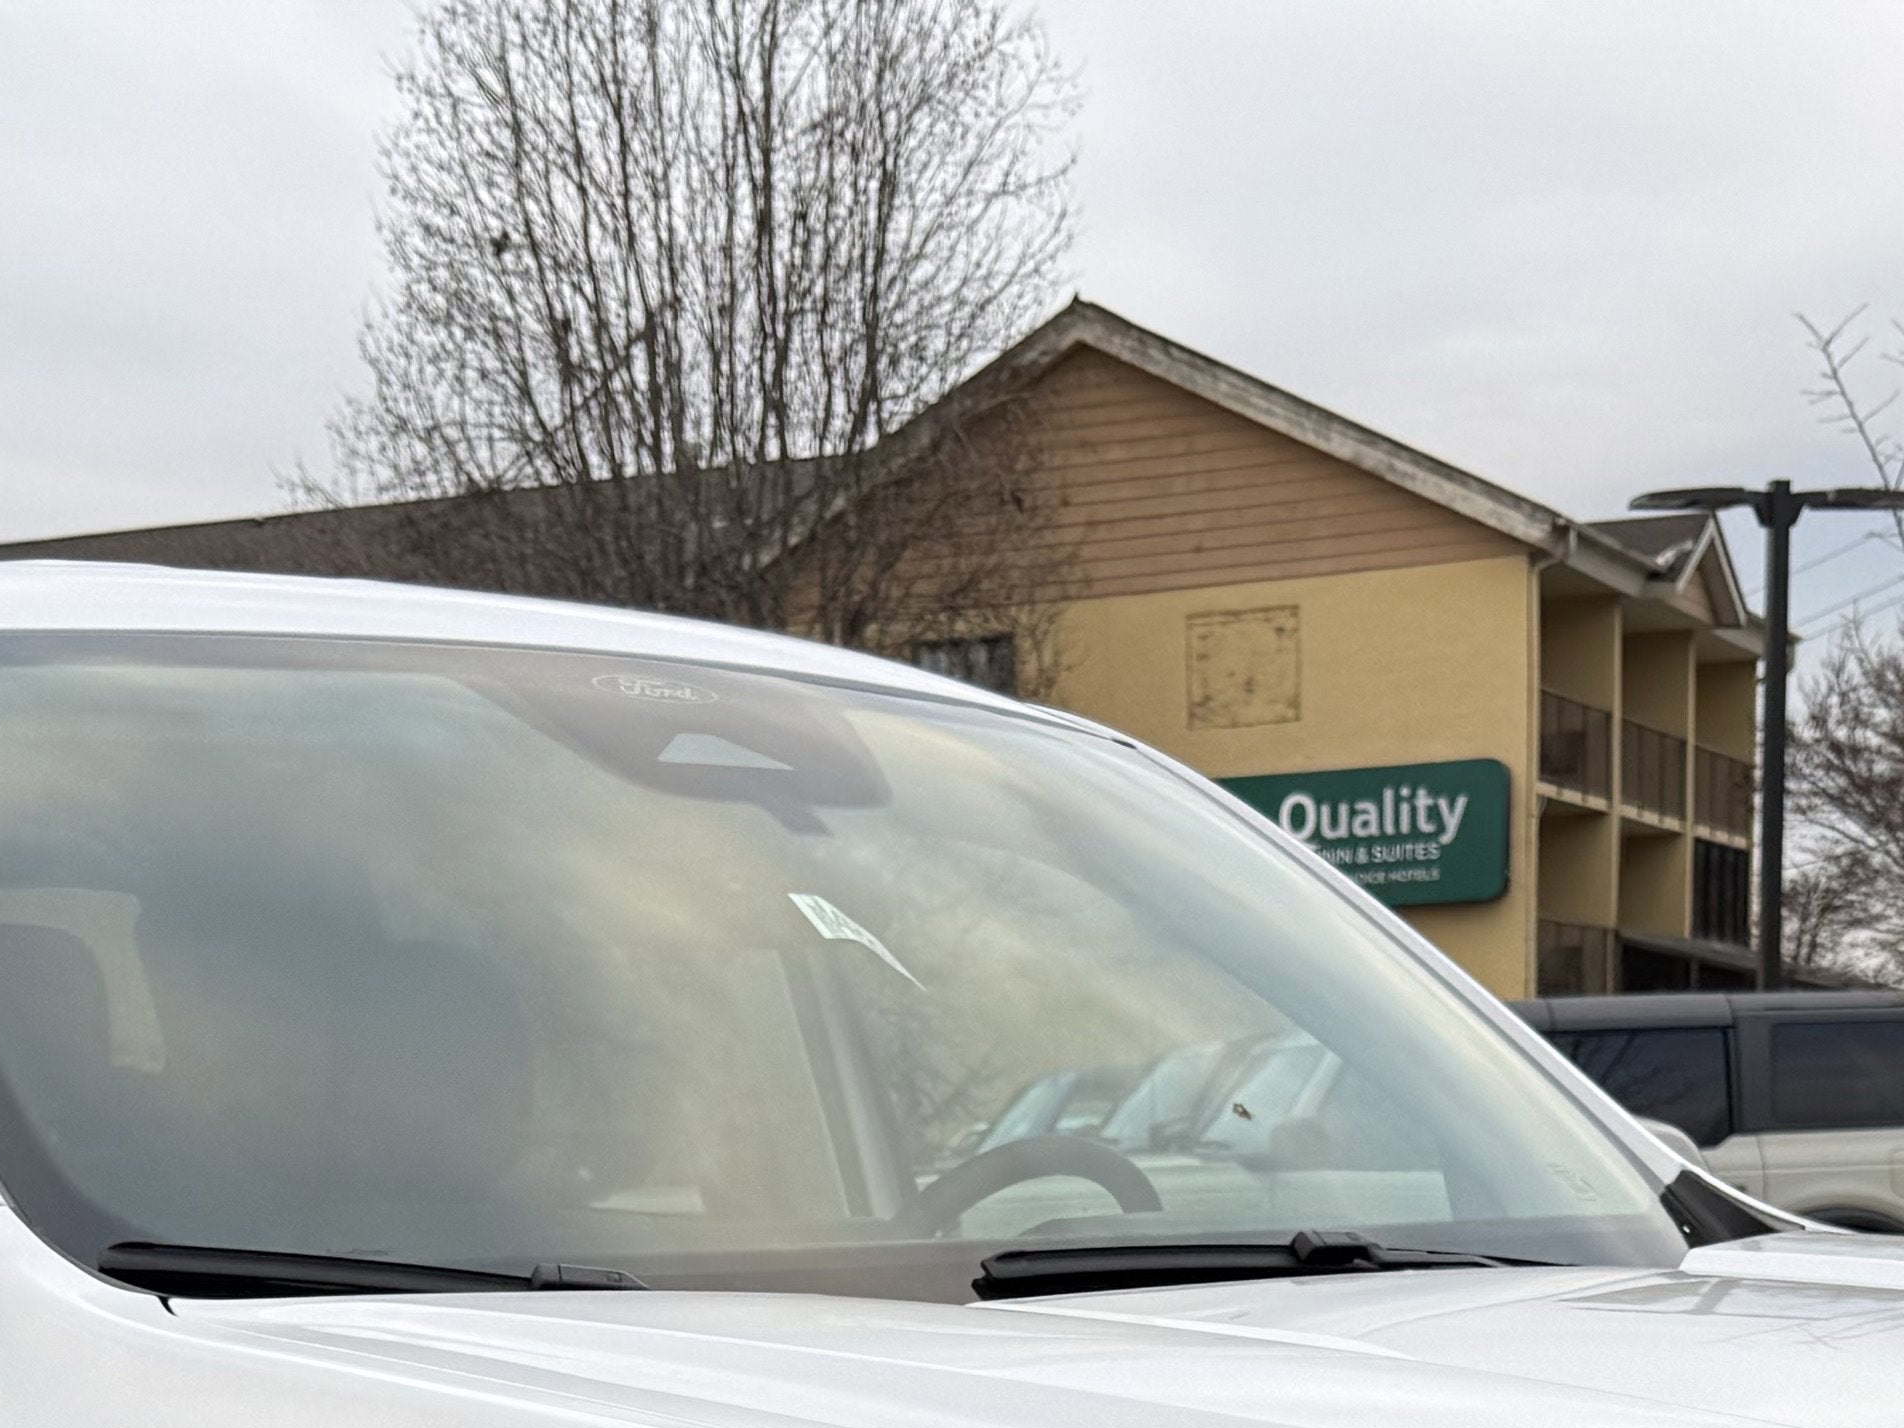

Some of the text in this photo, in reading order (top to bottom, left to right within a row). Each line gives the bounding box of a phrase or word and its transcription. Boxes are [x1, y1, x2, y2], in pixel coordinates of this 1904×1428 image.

[617, 677, 698, 701] Ford
[1279, 787, 1467, 845] Quality
[1371, 842, 1441, 863] SUITES
